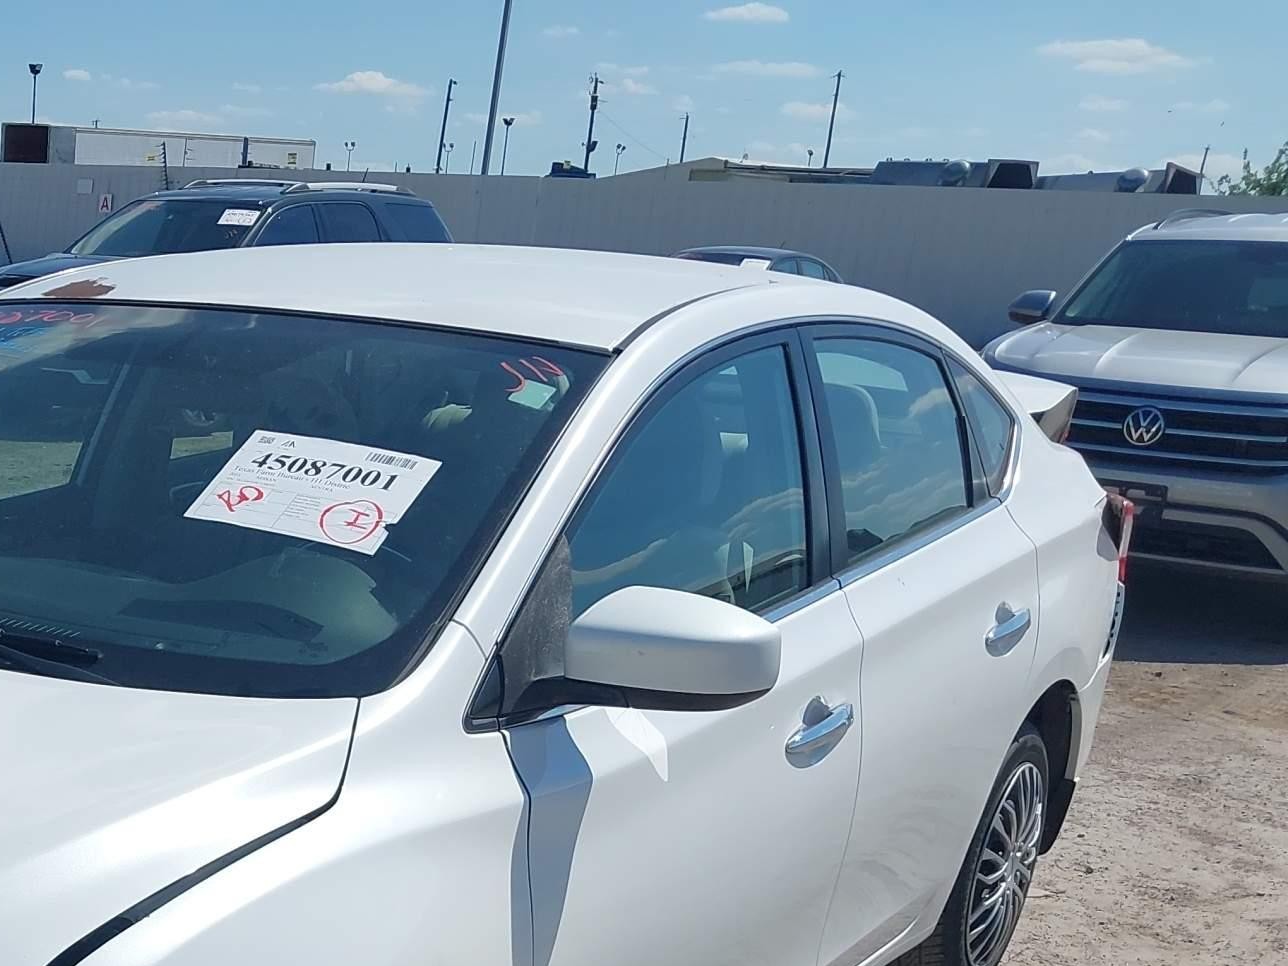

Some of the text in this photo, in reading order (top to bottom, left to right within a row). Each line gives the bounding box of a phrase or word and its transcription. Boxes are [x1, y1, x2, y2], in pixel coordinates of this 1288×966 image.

[100, 196, 109, 211] A
[234, 465, 255, 473] Texas
[255, 469, 276, 477] Farm
[277, 471, 304, 481] Bureau
[251, 453, 399, 491] 45087001
